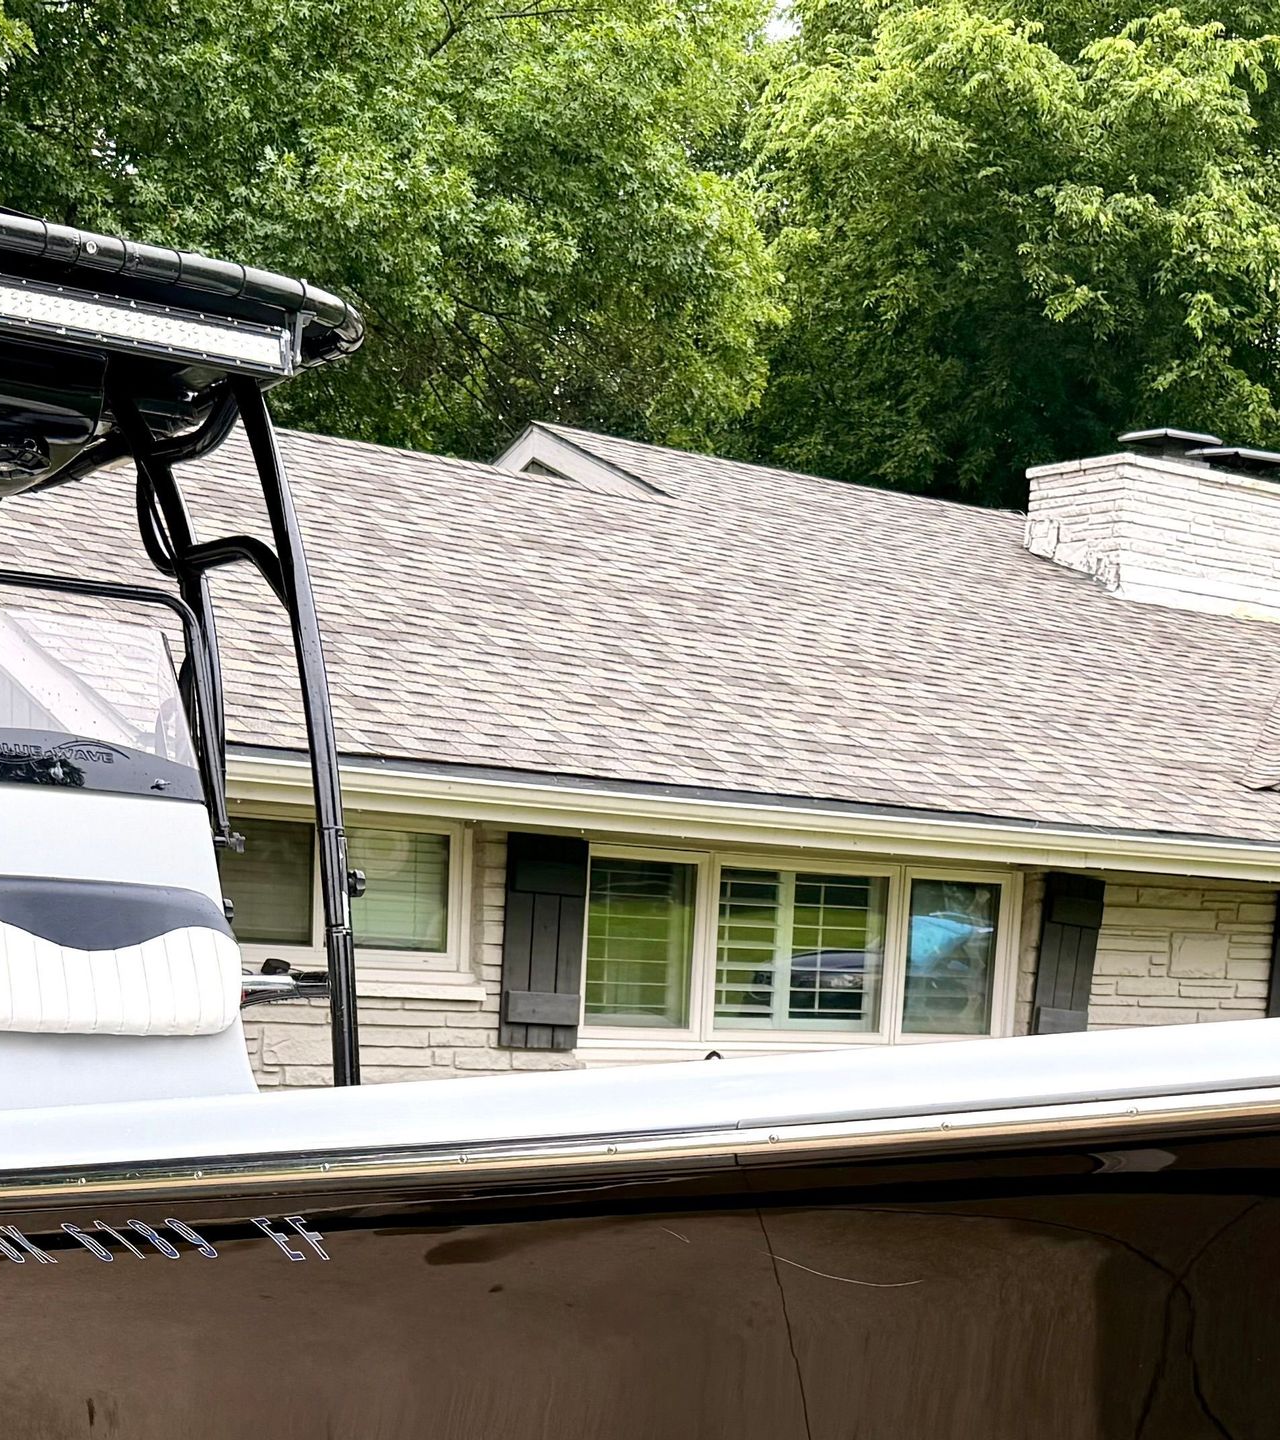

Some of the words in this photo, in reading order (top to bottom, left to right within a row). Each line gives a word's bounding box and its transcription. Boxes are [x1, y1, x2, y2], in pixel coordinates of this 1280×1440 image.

[53, 747, 115, 764] WAVE
[61, 1218, 218, 1262] 6189
[250, 1216, 330, 1261] EF
